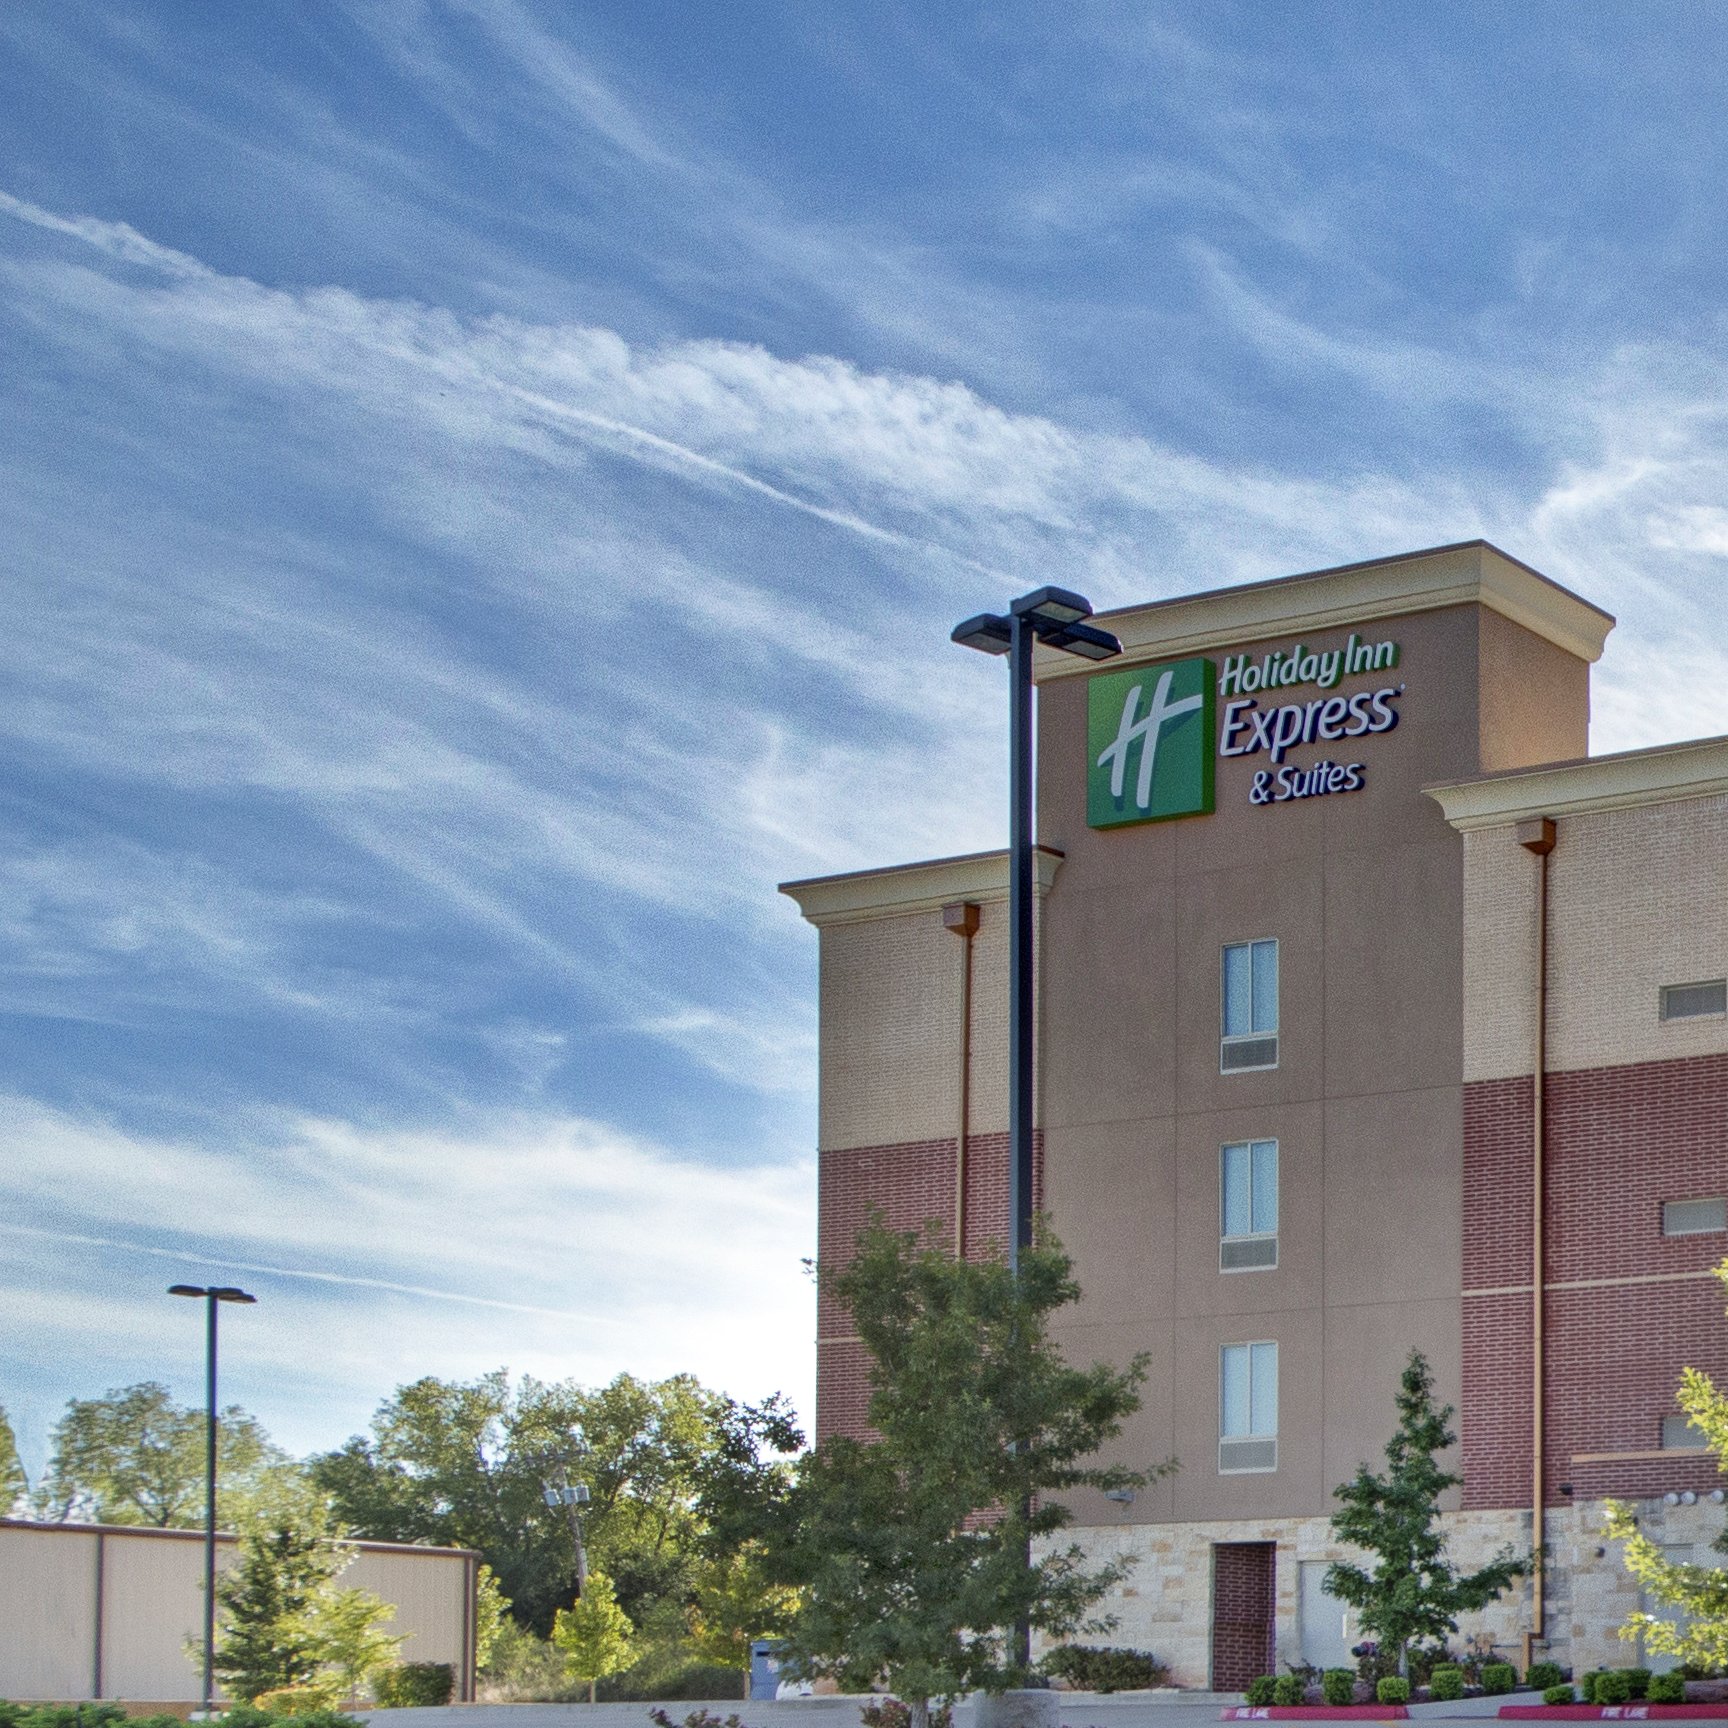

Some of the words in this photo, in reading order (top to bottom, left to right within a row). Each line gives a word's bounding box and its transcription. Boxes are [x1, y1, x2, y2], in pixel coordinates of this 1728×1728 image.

[1219, 645, 1341, 696] Holiday
[1344, 634, 1395, 674] Inn
[1219, 688, 1397, 763] Express
[1249, 771, 1269, 804] &
[1275, 761, 1361, 801] Suites
